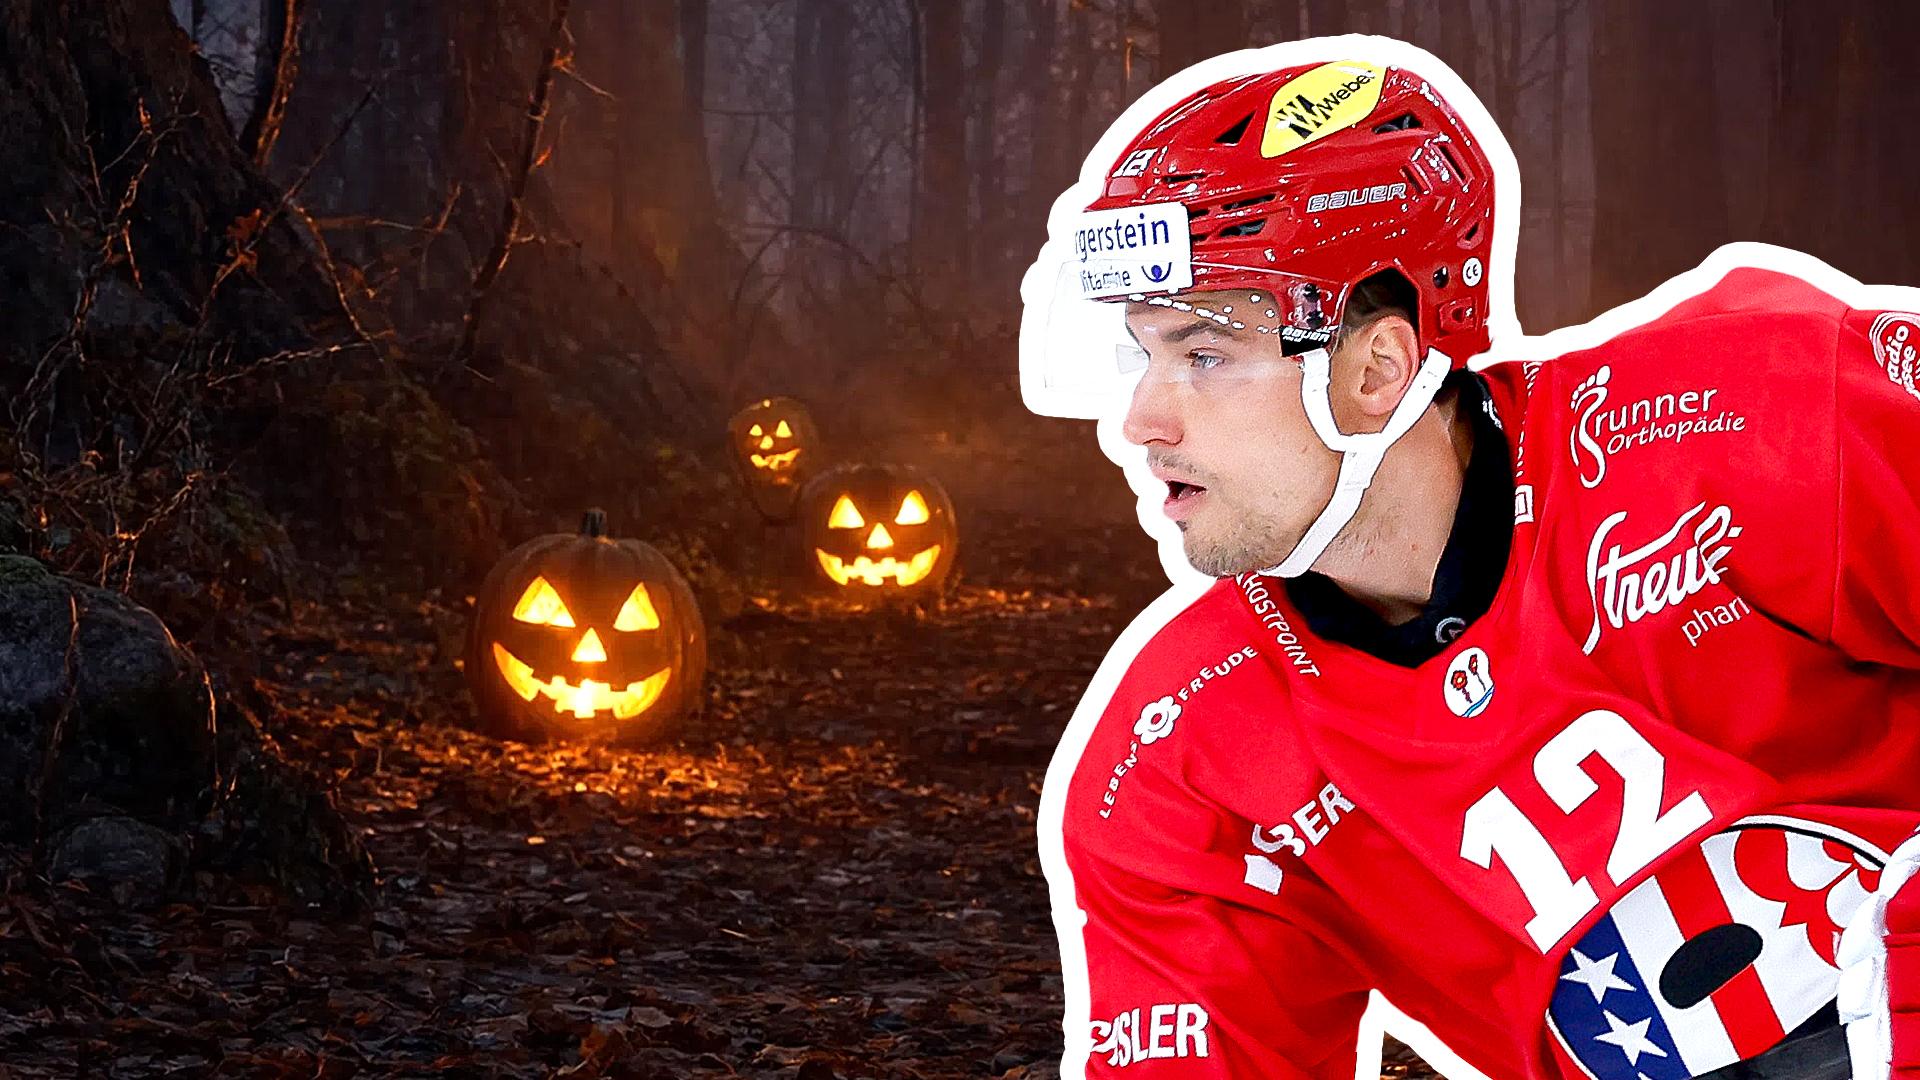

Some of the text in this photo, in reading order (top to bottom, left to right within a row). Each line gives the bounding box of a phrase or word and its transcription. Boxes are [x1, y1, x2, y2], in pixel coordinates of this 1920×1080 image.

[1306, 183, 1407, 213] BAUER
[1607, 412, 1746, 455] Orthopädie
[1242, 573, 1320, 677] HOSTPOINT
[1177, 645, 1259, 702] FREUDE
[1459, 709, 1714, 956] 12
